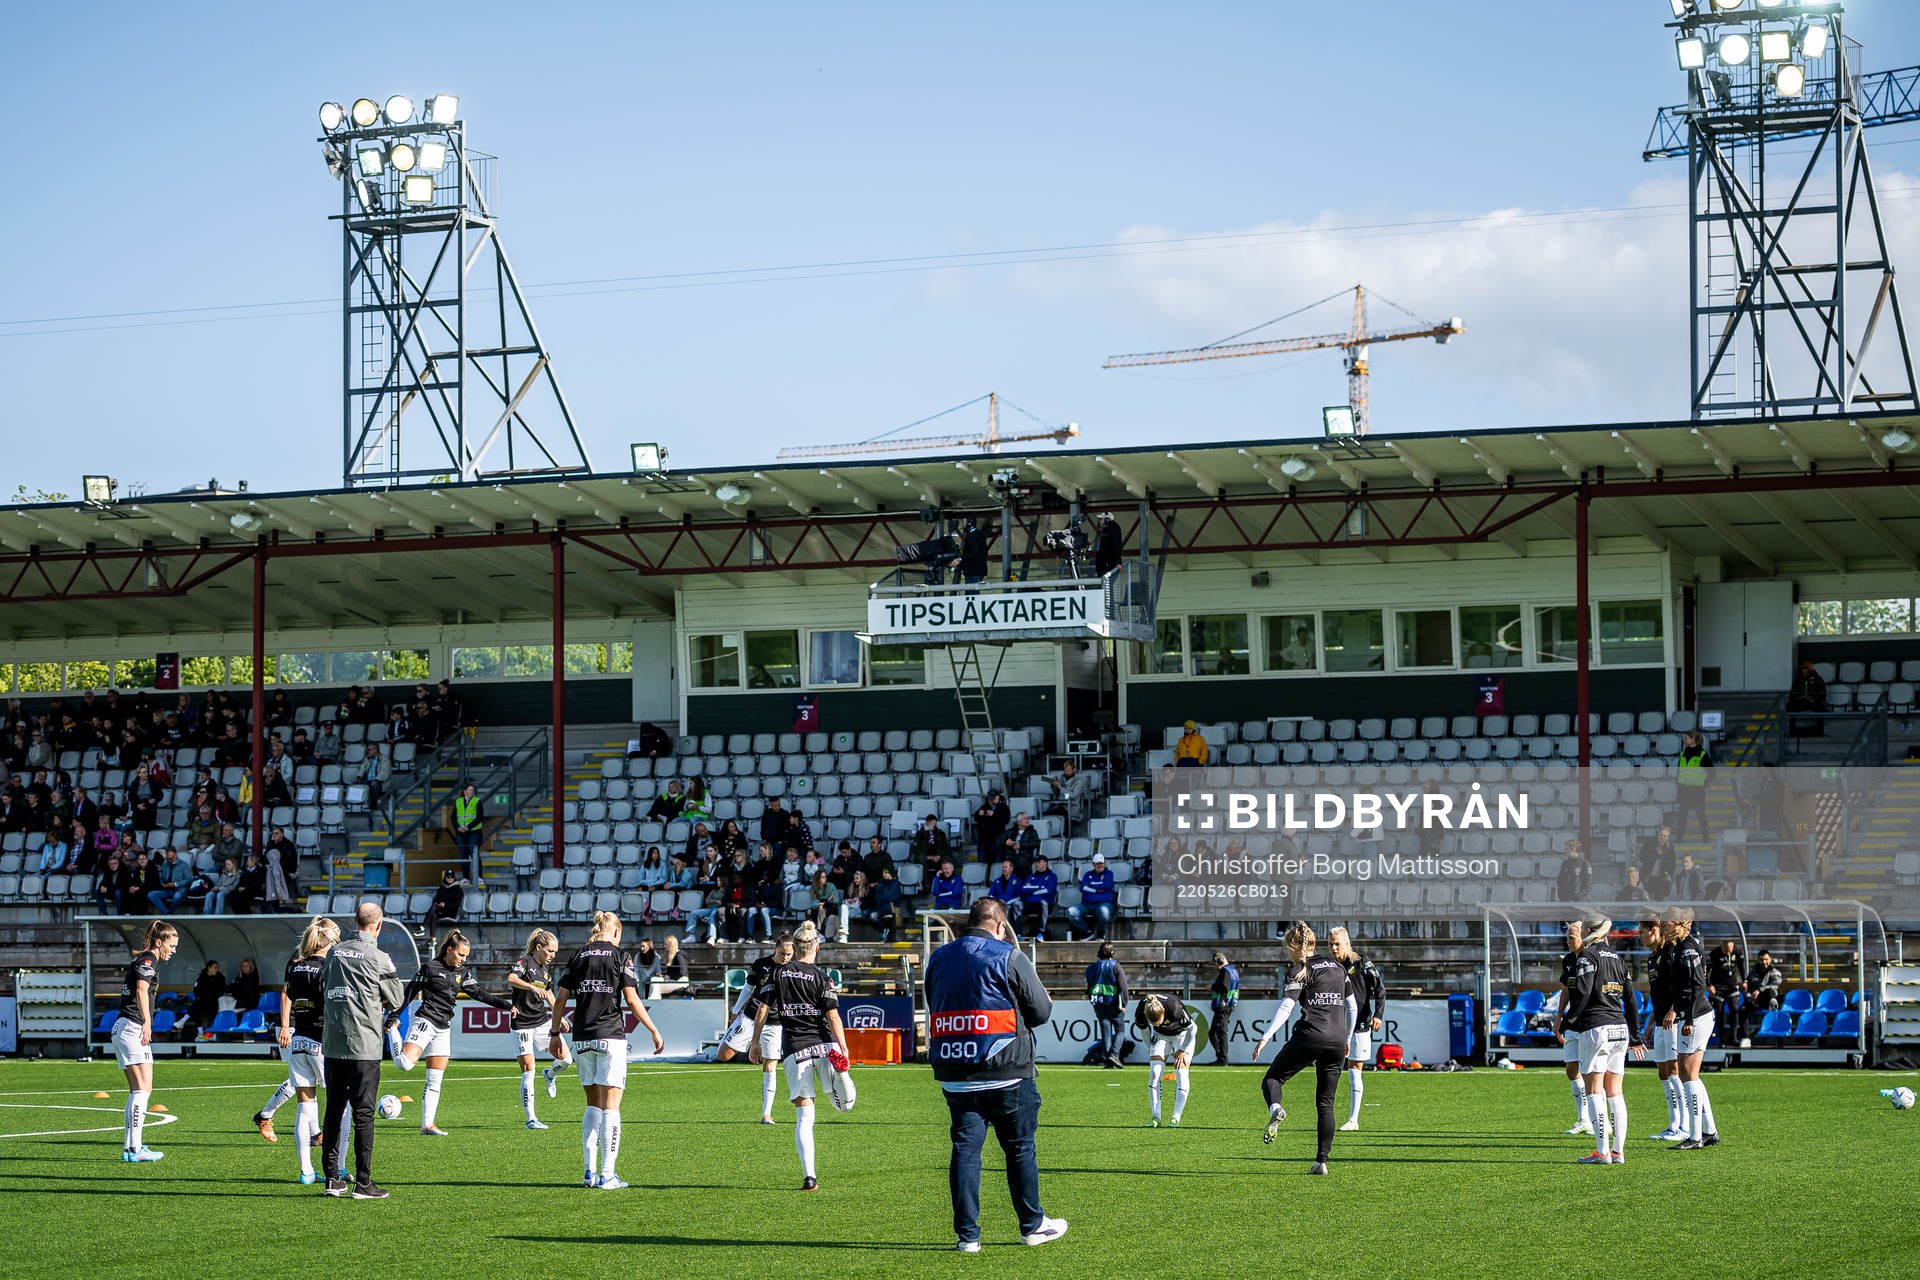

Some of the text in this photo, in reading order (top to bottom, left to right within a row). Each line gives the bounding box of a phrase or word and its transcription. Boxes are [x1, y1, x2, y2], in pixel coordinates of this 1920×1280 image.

[885, 596, 1087, 628] TIPSLÄKTAREN
[163, 669, 170, 679] 2
[1485, 691, 1493, 703] 3
[801, 710, 809, 721] 3
[333, 950, 364, 960] stadium
[580, 949, 613, 958] stadium
[293, 965, 320, 974] stadium
[782, 970, 815, 982] stadium
[779, 1009, 822, 1017] WELLNESS
[853, 1016, 880, 1028] FCR
[935, 1015, 989, 1033] PHOTO
[940, 1042, 977, 1059] 030
